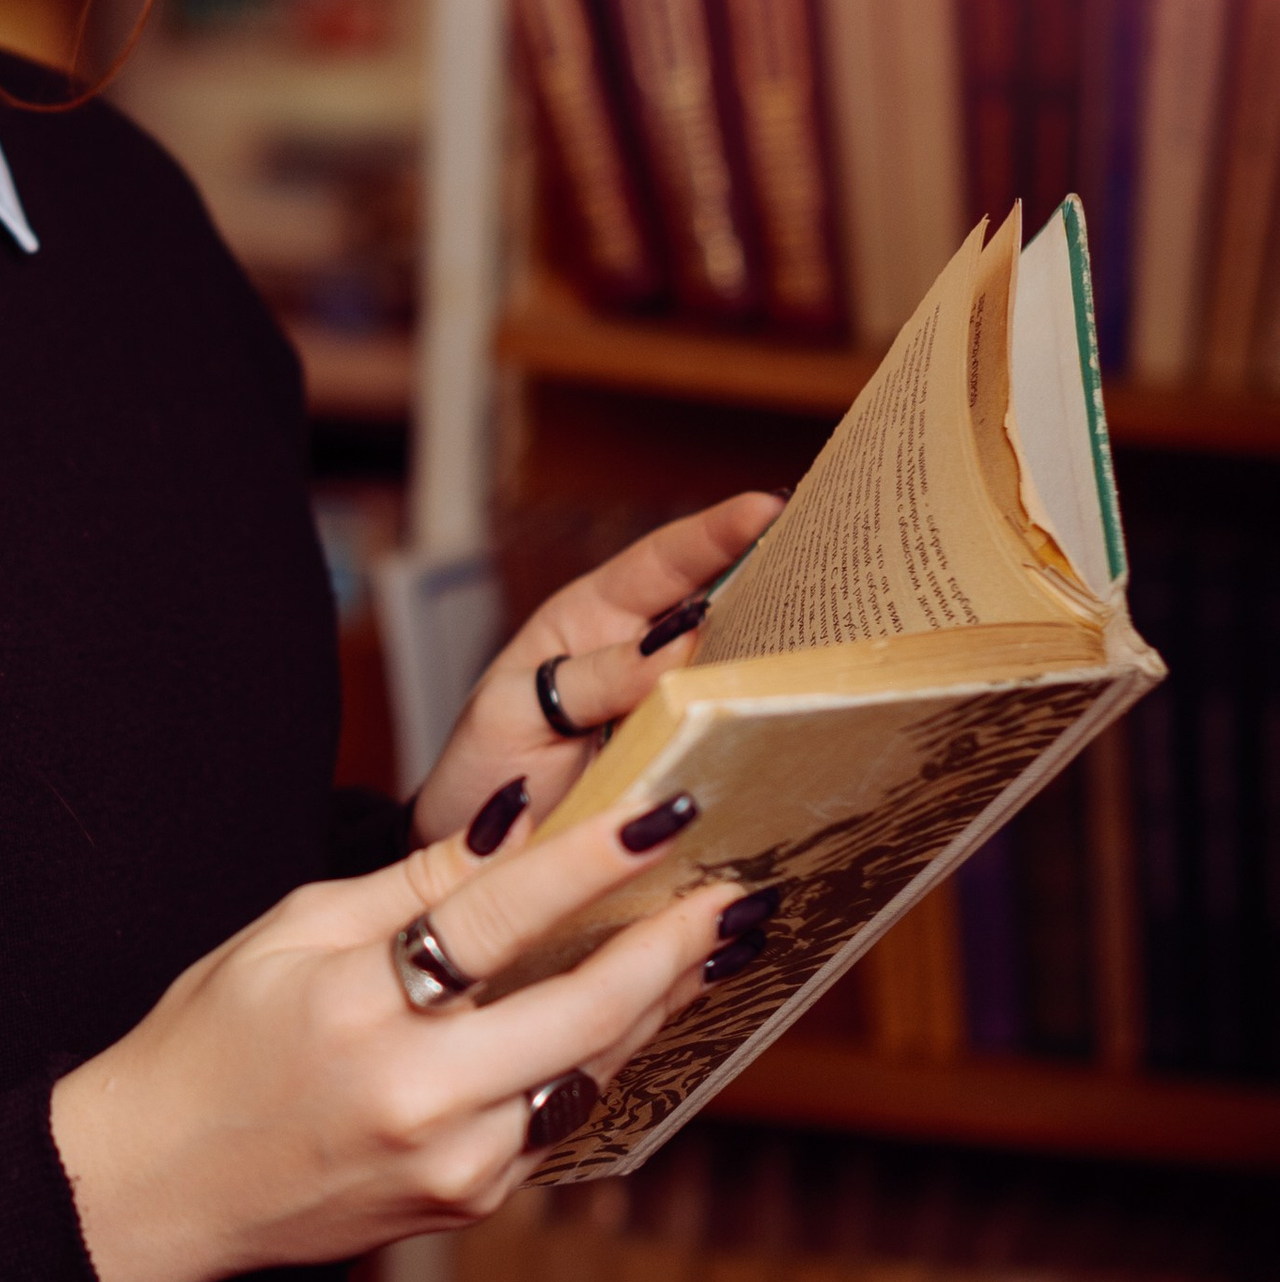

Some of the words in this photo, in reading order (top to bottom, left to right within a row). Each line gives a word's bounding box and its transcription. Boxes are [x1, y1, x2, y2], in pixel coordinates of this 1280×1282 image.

[861, 509, 872, 568] гербарий
[875, 544, 884, 569] что
[898, 516, 921, 591] обществом
[906, 465, 920, 533] Приморье
[915, 535, 930, 570] трав,
[926, 571, 955, 621] птичьи
[917, 443, 927, 495] задание
[926, 514, 948, 570] собрать
[947, 577, 980, 625] гербар
[840, 533, 850, 601] бумажную
[852, 545, 860, 586] найти
[820, 600, 828, 639] птицу
[866, 571, 883, 625] собрать
